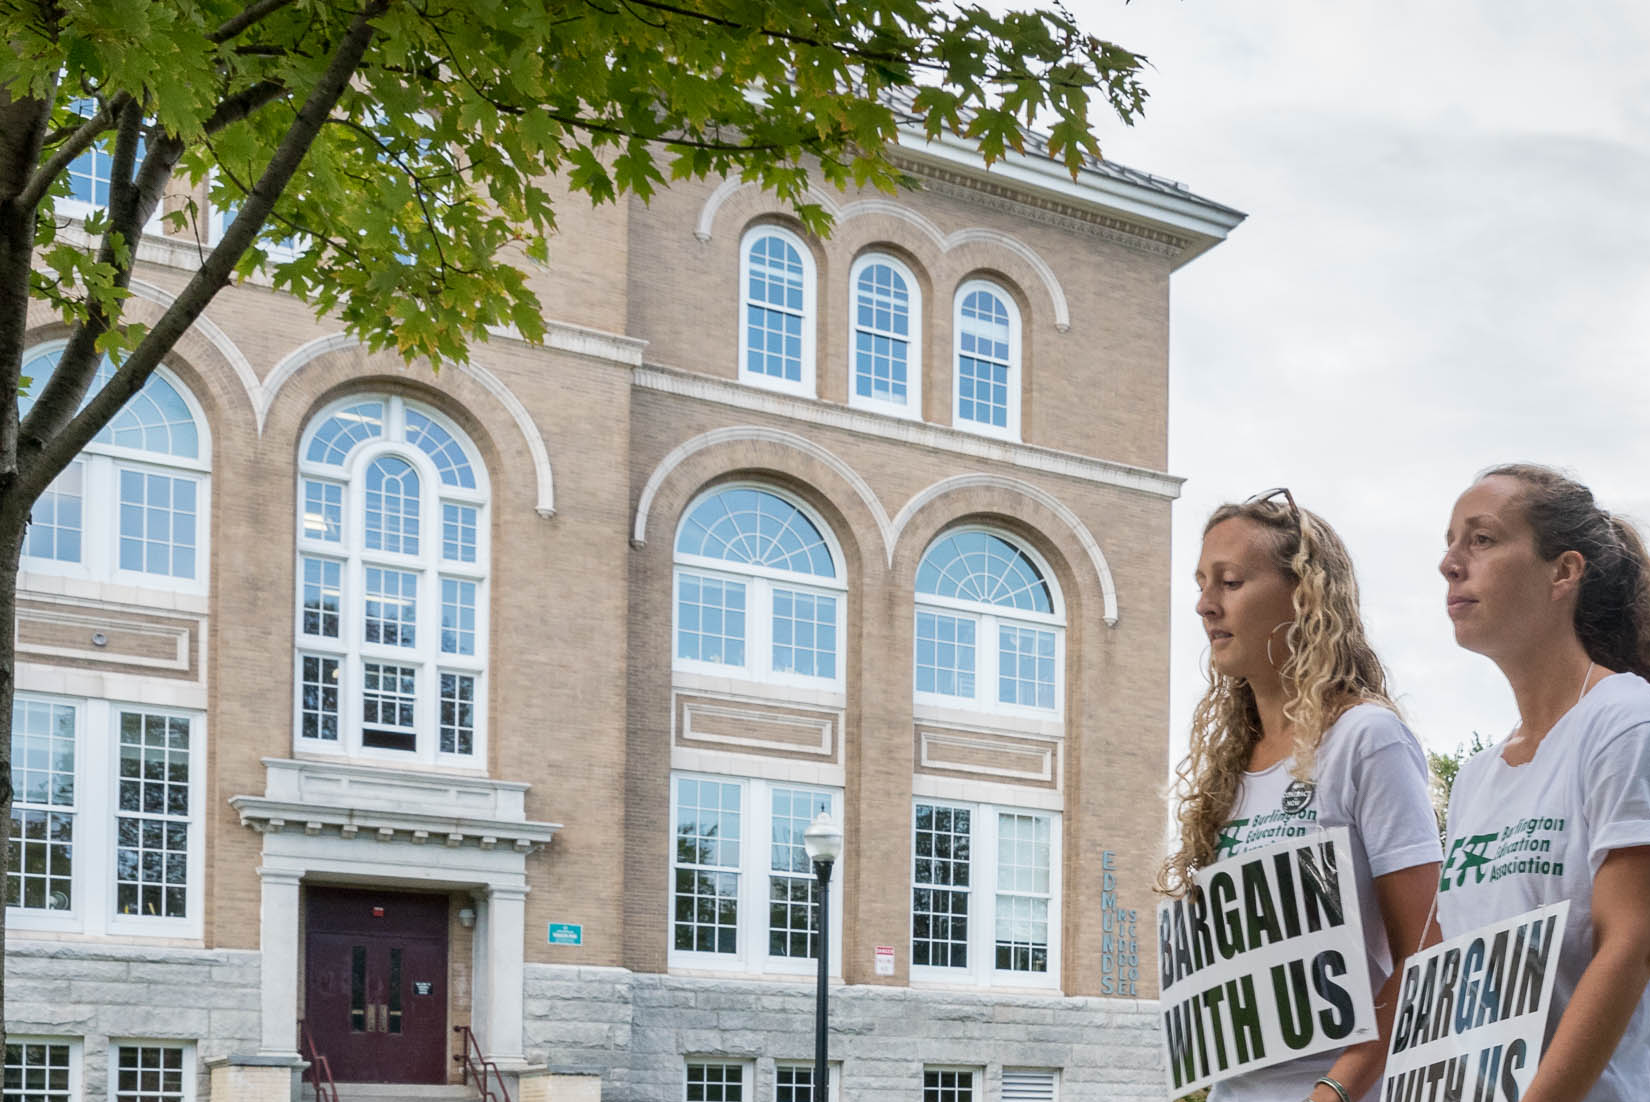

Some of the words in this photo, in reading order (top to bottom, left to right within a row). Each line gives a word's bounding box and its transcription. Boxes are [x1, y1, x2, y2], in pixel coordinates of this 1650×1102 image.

[1246, 826, 1306, 844] Education
[1101, 850, 1117, 995] EDMUNDS
[1117, 908, 1127, 995] MIDDLE
[1127, 909, 1138, 996] SCHOOL
[1160, 841, 1345, 991] BARGAIN
[1392, 914, 1556, 1055] BARGAIN
[1165, 974, 1266, 1091] WITH
[1270, 950, 1355, 1051] US
